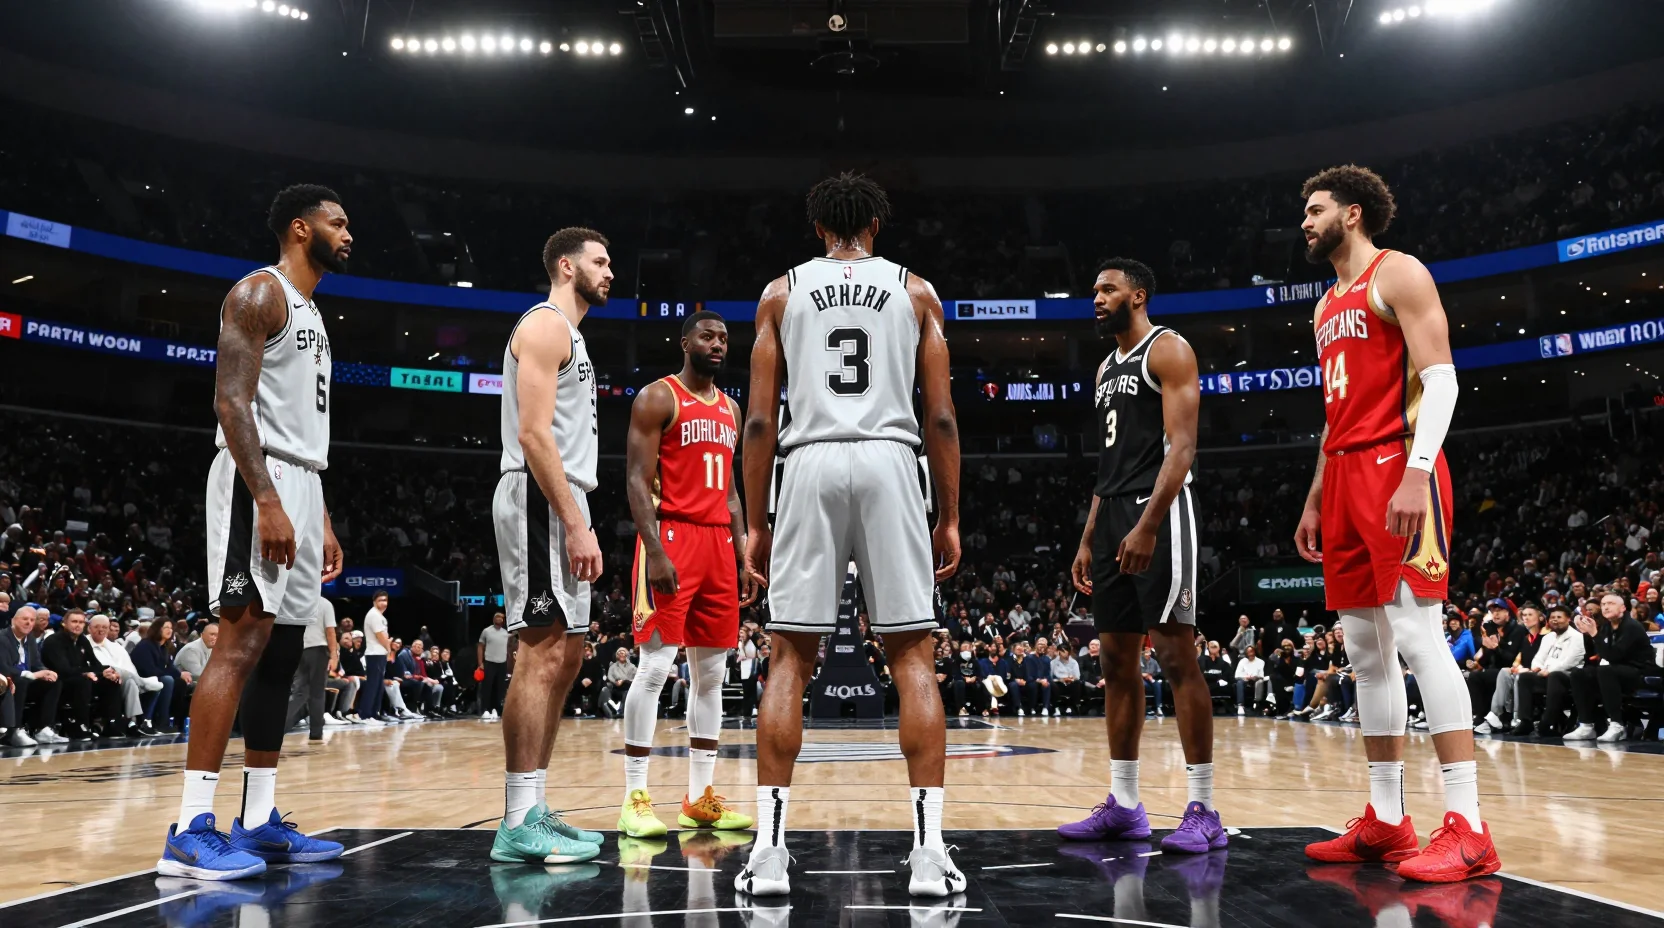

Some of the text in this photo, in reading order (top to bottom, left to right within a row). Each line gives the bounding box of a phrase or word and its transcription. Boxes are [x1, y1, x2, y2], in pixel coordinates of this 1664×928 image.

[27, 321, 141, 352] PARTH WOON
[825, 326, 872, 397] 3
[1325, 351, 1348, 403] 14
[315, 372, 327, 414] 6
[1105, 409, 1117, 448] 3
[703, 451, 724, 491] 11
